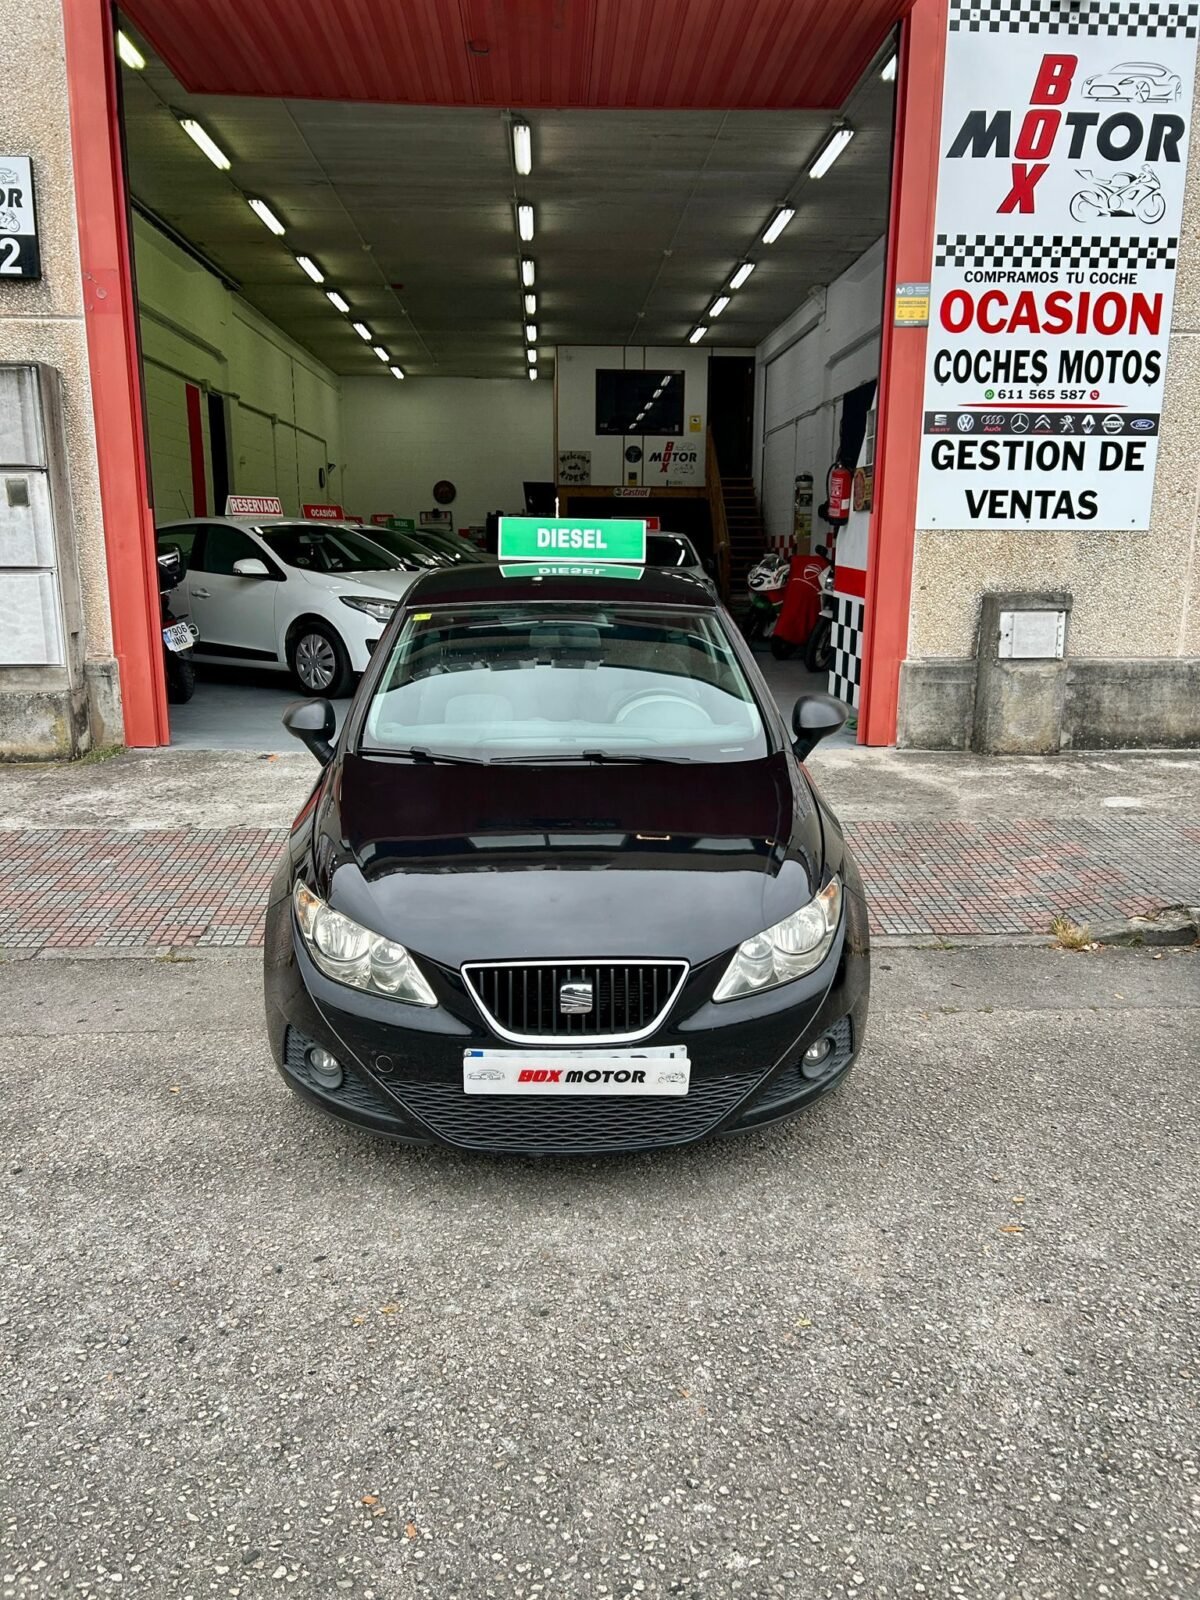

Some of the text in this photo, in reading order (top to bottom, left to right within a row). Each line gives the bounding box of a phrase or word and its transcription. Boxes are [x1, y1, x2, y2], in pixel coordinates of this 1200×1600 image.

[945, 109, 1185, 162] MOTOR
[996, 54, 1078, 213] BOX
[964, 271, 1138, 285] COMPRAMOS TU COCHE
[939, 289, 1163, 336] OCASION
[934, 349, 1162, 385] COCHES MOTOS
[997, 389, 1087, 400] 611 565 587
[649, 452, 697, 462] MOTOR
[660, 441, 675, 473] BOX
[930, 440, 1147, 472] GESTION DE
[622, 488, 649, 497] Castrol
[230, 498, 280, 513] RESERVADO
[310, 508, 337, 518] OCASIÓN
[964, 489, 1098, 520] VENTAS
[537, 527, 607, 549] DIESEL
[518, 1069, 646, 1084] BOX MOTOR
